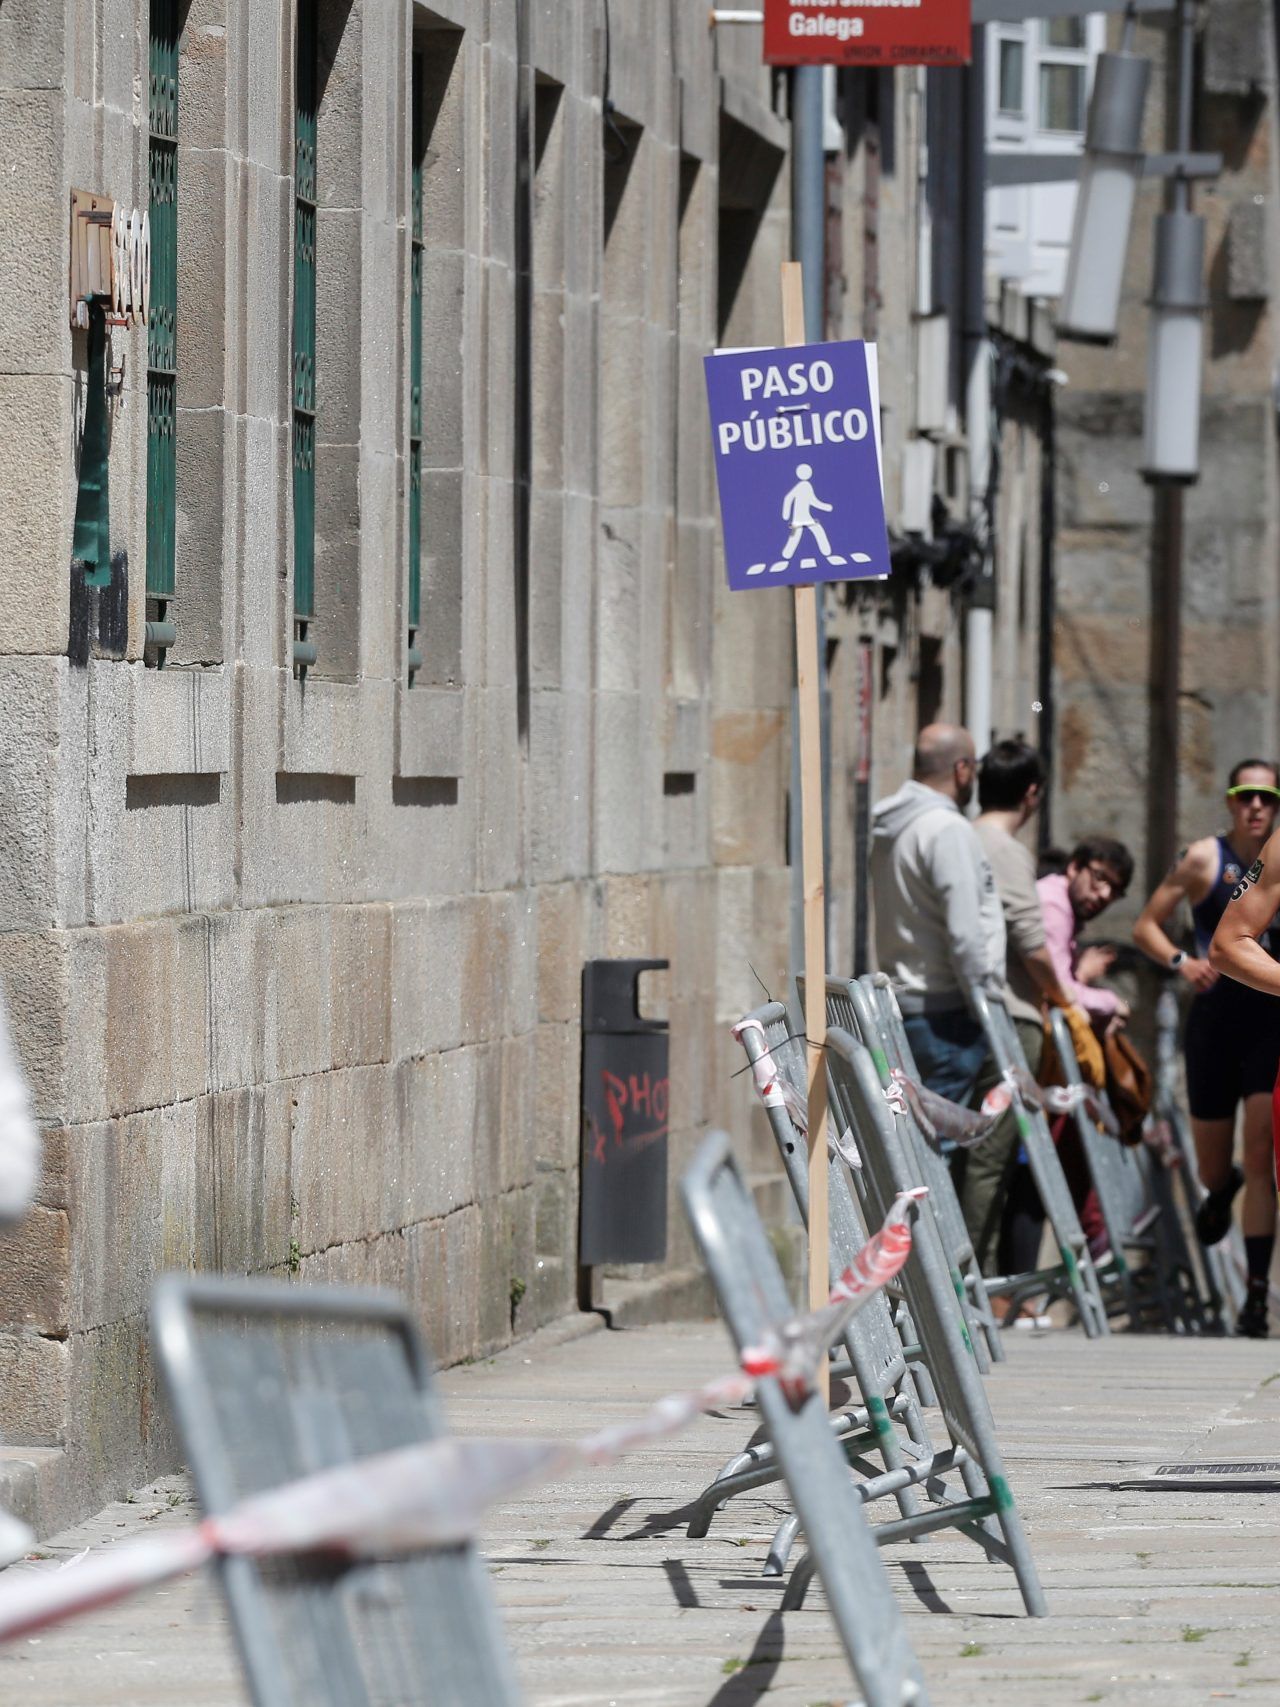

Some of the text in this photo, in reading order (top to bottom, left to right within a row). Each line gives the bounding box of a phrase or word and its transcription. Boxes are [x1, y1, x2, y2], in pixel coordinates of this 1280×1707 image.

[788, 12, 864, 41] Galega
[740, 360, 834, 401] PASO
[718, 408, 868, 455] PÚBLICO
